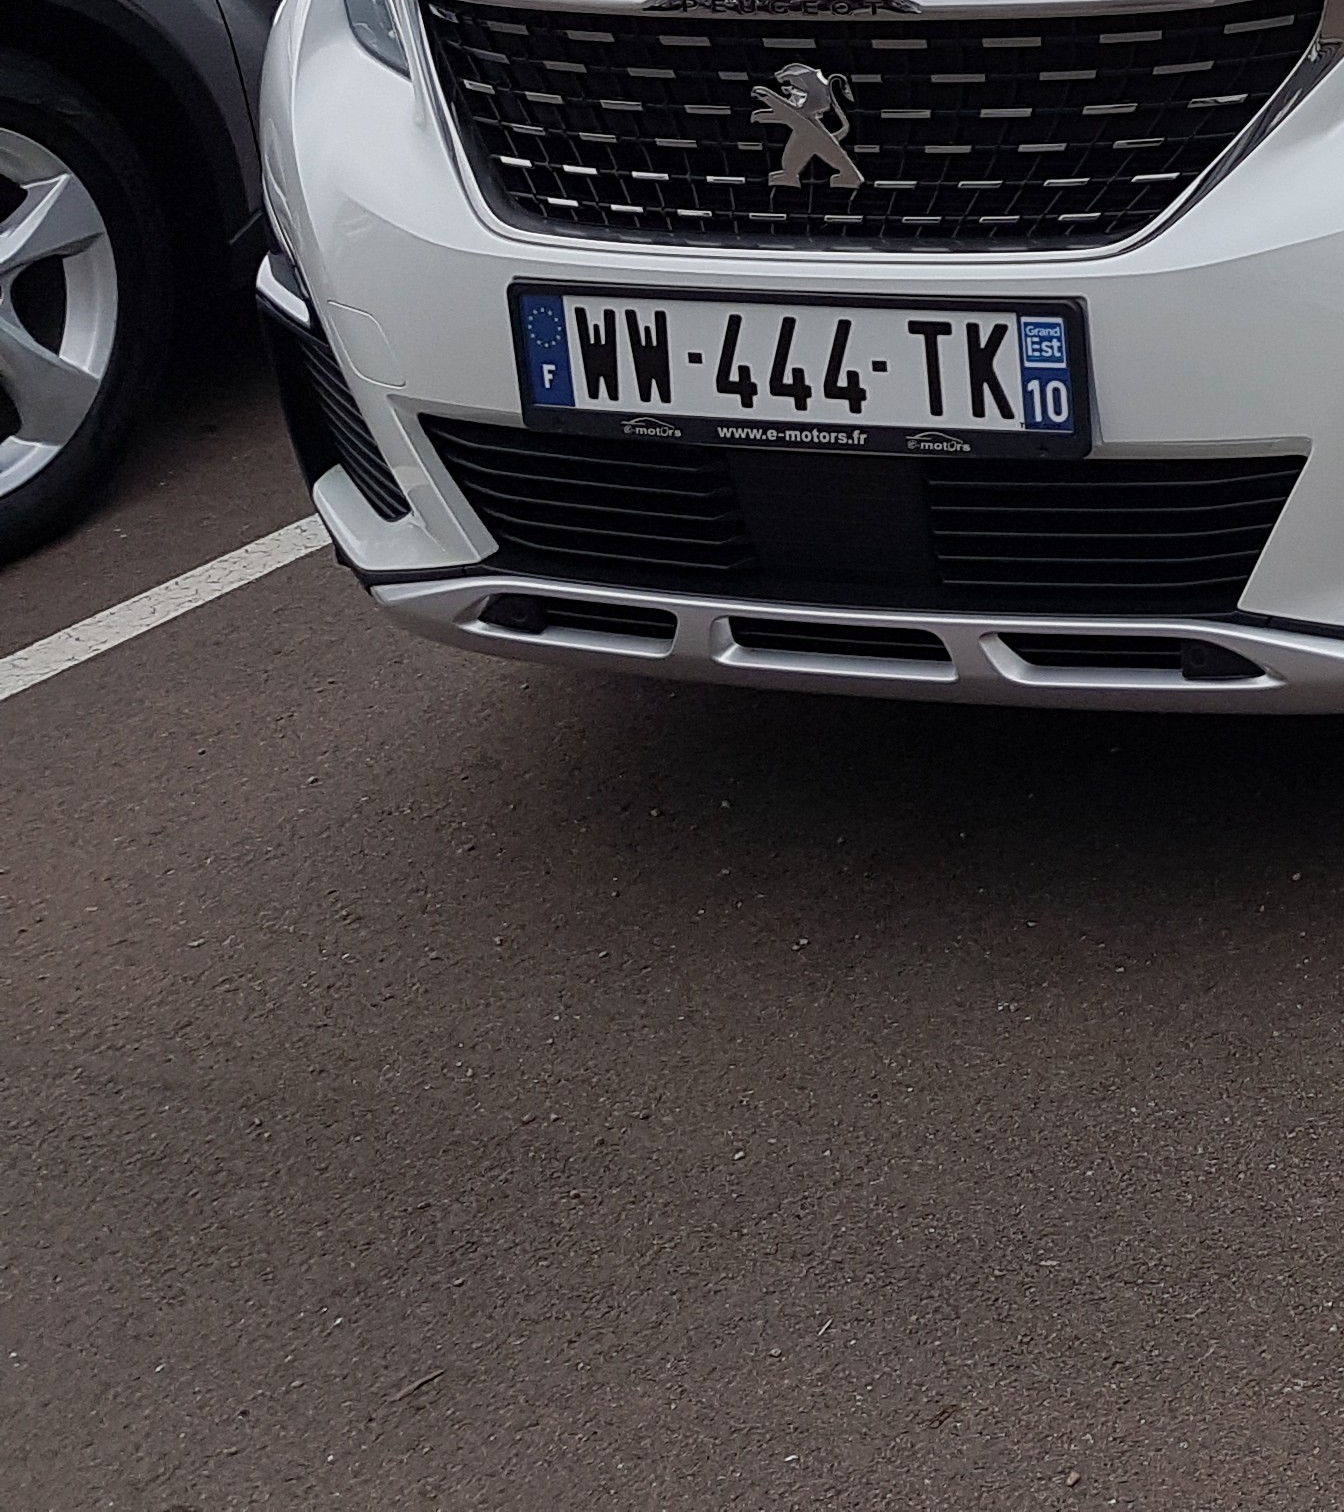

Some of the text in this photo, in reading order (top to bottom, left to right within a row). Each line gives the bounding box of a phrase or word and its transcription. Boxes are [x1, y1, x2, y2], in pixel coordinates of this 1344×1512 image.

[1025, 325, 1061, 337] Grand
[1026, 337, 1062, 357] Est
[542, 363, 556, 389] F
[1027, 379, 1069, 423] 10
[716, 426, 868, 446] www.e-motors.fr
